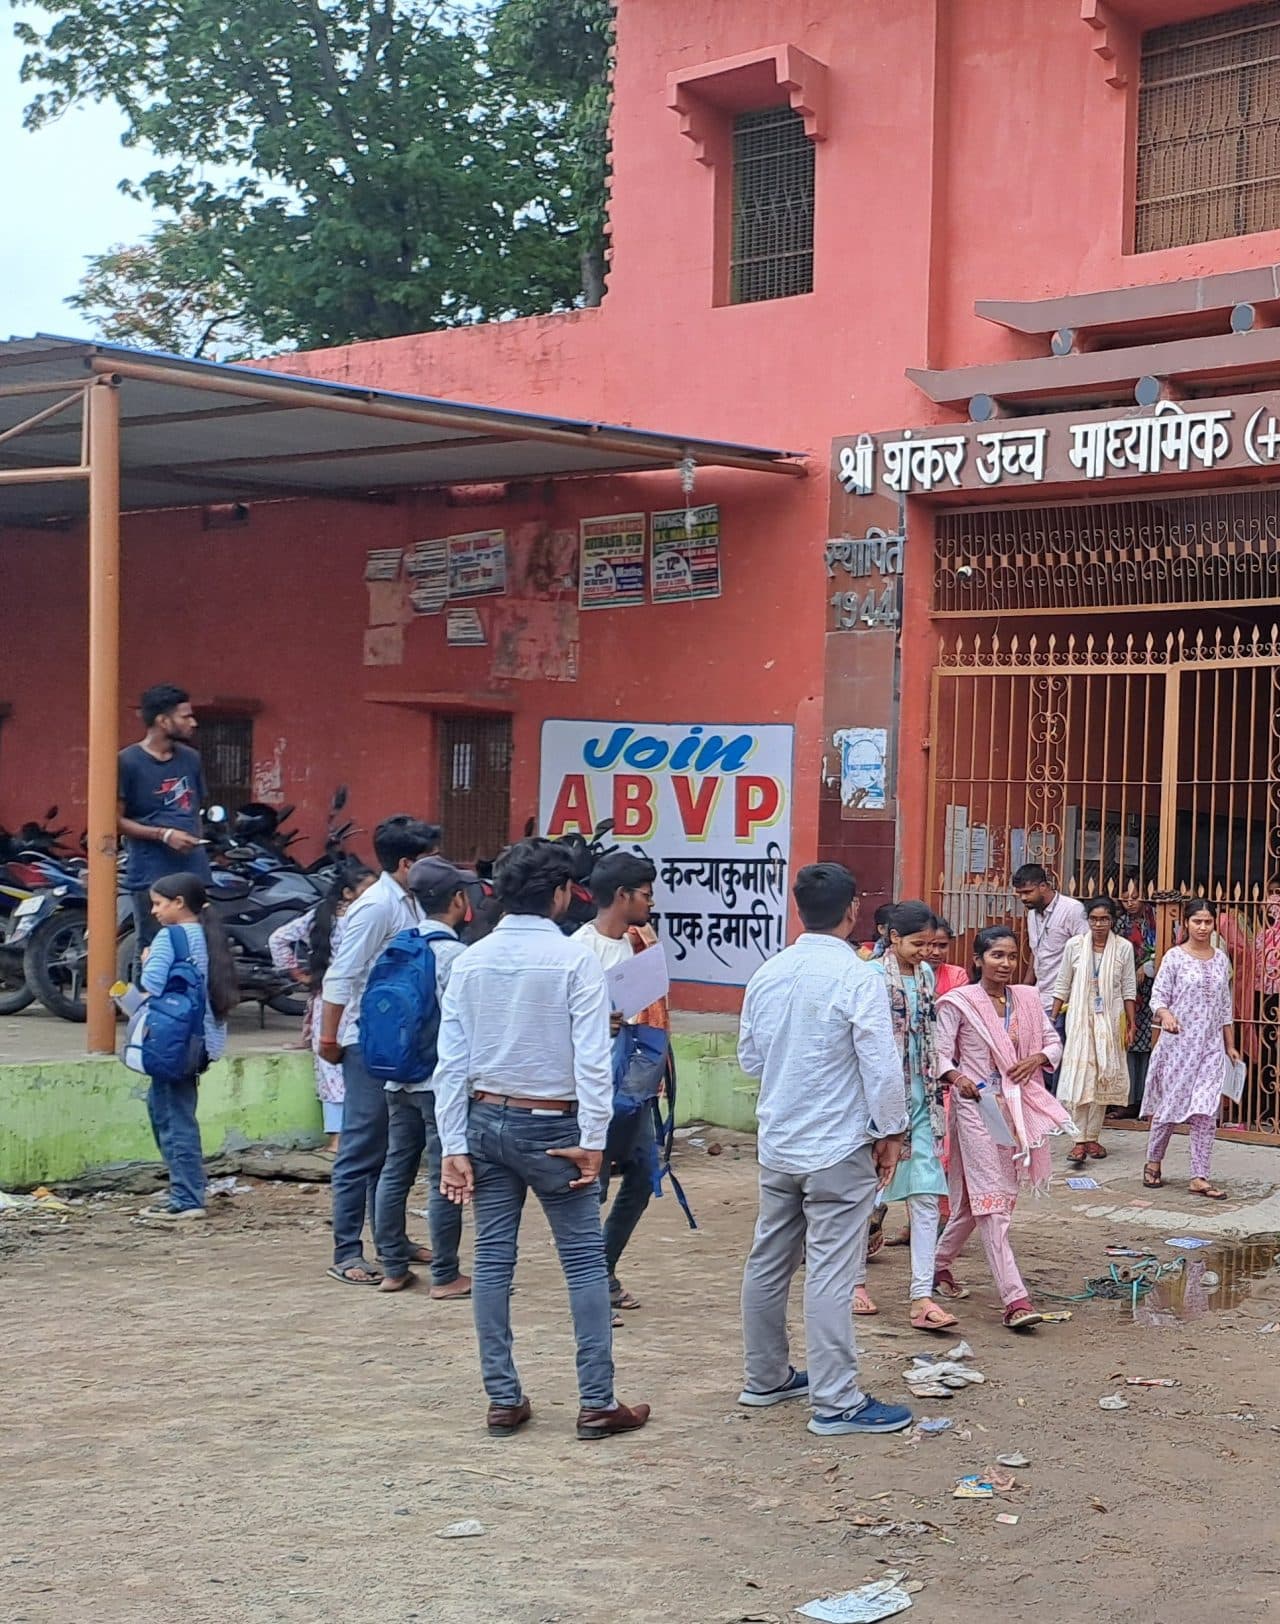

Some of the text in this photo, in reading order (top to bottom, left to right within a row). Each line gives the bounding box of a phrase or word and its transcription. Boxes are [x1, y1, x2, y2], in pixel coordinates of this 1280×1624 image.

[838, 433, 875, 495] श्री
[882, 430, 966, 492] शंकर
[976, 428, 1047, 484] उच्च
[1069, 400, 1233, 478] माध्यमिक
[824, 527, 907, 577] स्थापित
[583, 727, 754, 772] Join
[660, 841, 788, 908] कन्याकुमारी
[664, 912, 703, 961] एक
